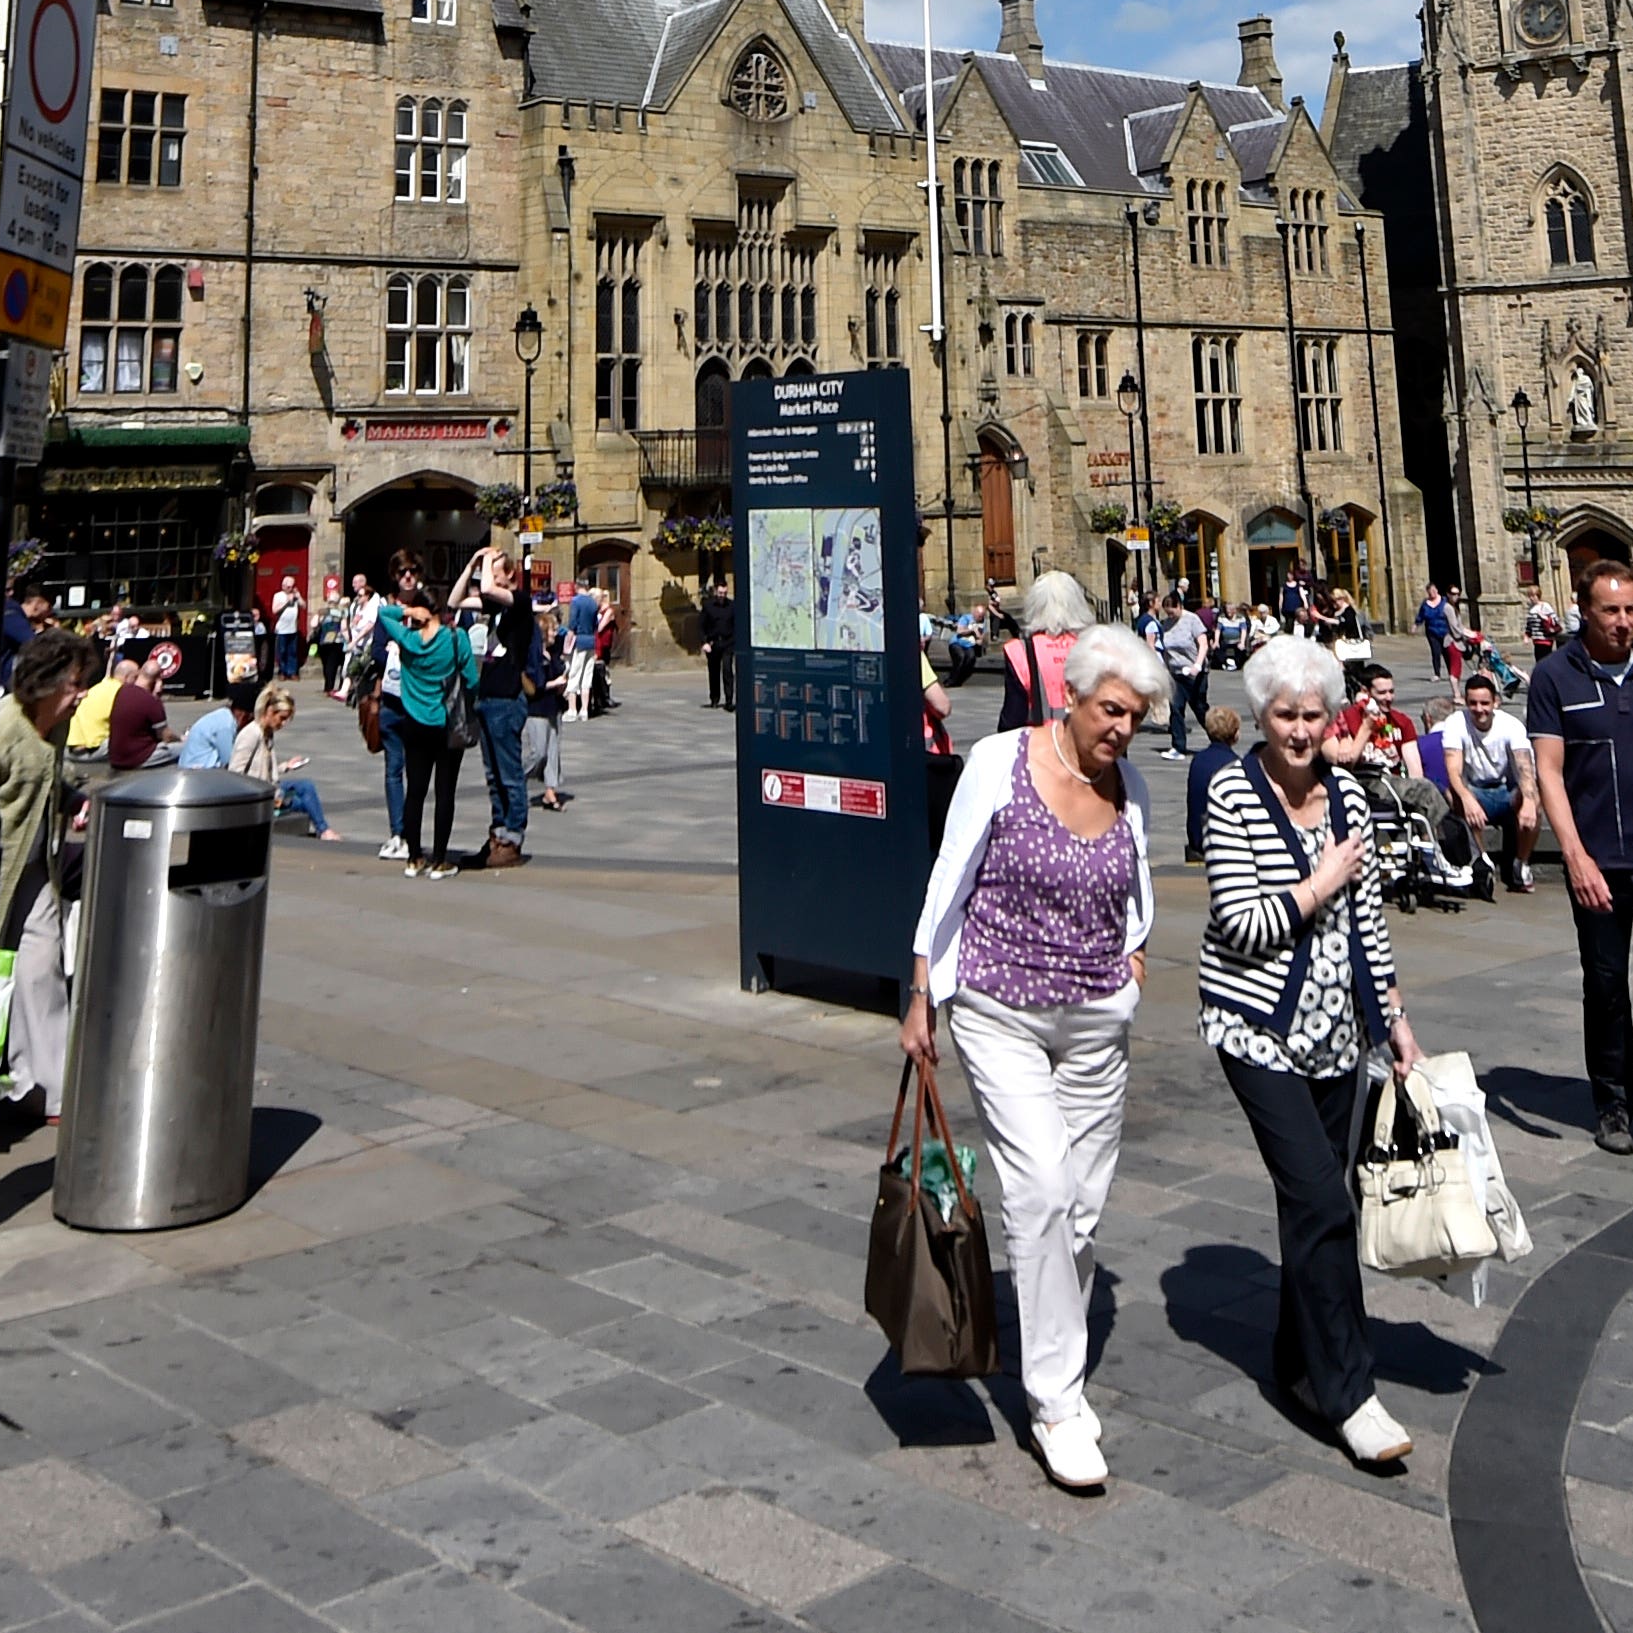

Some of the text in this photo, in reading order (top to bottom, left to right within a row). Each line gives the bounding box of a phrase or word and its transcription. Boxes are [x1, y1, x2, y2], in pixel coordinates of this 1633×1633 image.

[18, 116, 77, 163] No vehicles
[17, 164, 70, 205] Except for
[23, 192, 61, 232] loading
[7, 218, 17, 240] 4
[18, 225, 35, 246] pm
[42, 229, 55, 253] 10
[54, 240, 68, 258] am
[774, 380, 845, 401] DURHAM CITY
[779, 400, 840, 417] Market Place
[368, 423, 487, 441] MARKET HALL
[61, 469, 203, 486] MARKET TAVERN
